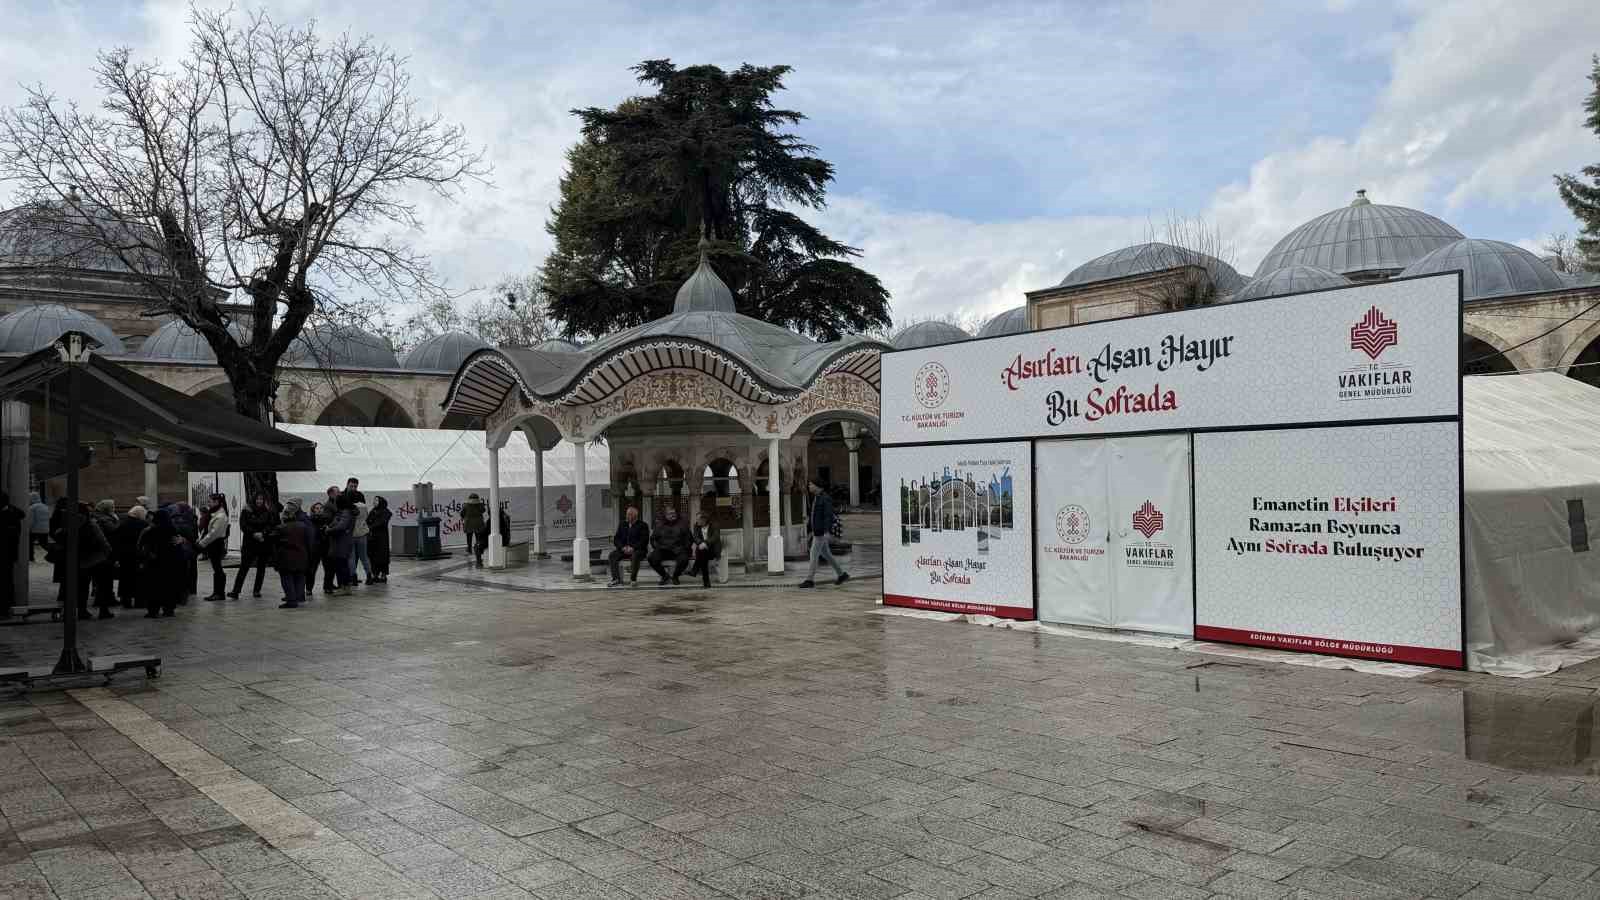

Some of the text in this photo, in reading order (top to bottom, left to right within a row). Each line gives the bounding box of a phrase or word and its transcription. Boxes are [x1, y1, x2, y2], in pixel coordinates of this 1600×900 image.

[1001, 333, 1234, 390] Asırları Aşan Hayır
[1338, 370, 1412, 388] VAKIFLAR
[1338, 390, 1361, 398] GENEL
[1046, 384, 1178, 426] Bu Sofrada
[1252, 496, 1396, 516] Emanetin Elçileri
[1249, 517, 1401, 538] Ramazan Boyunca
[1125, 547, 1174, 559] VAKIFLAR
[1227, 537, 1425, 562] Aynı Sofrada Buluşuyor
[942, 572, 971, 585] Sofrada
[1250, 632, 1394, 654] EDİRNE VAKIFLAR BÖLGE MÜDÜRLÜĞÜ
